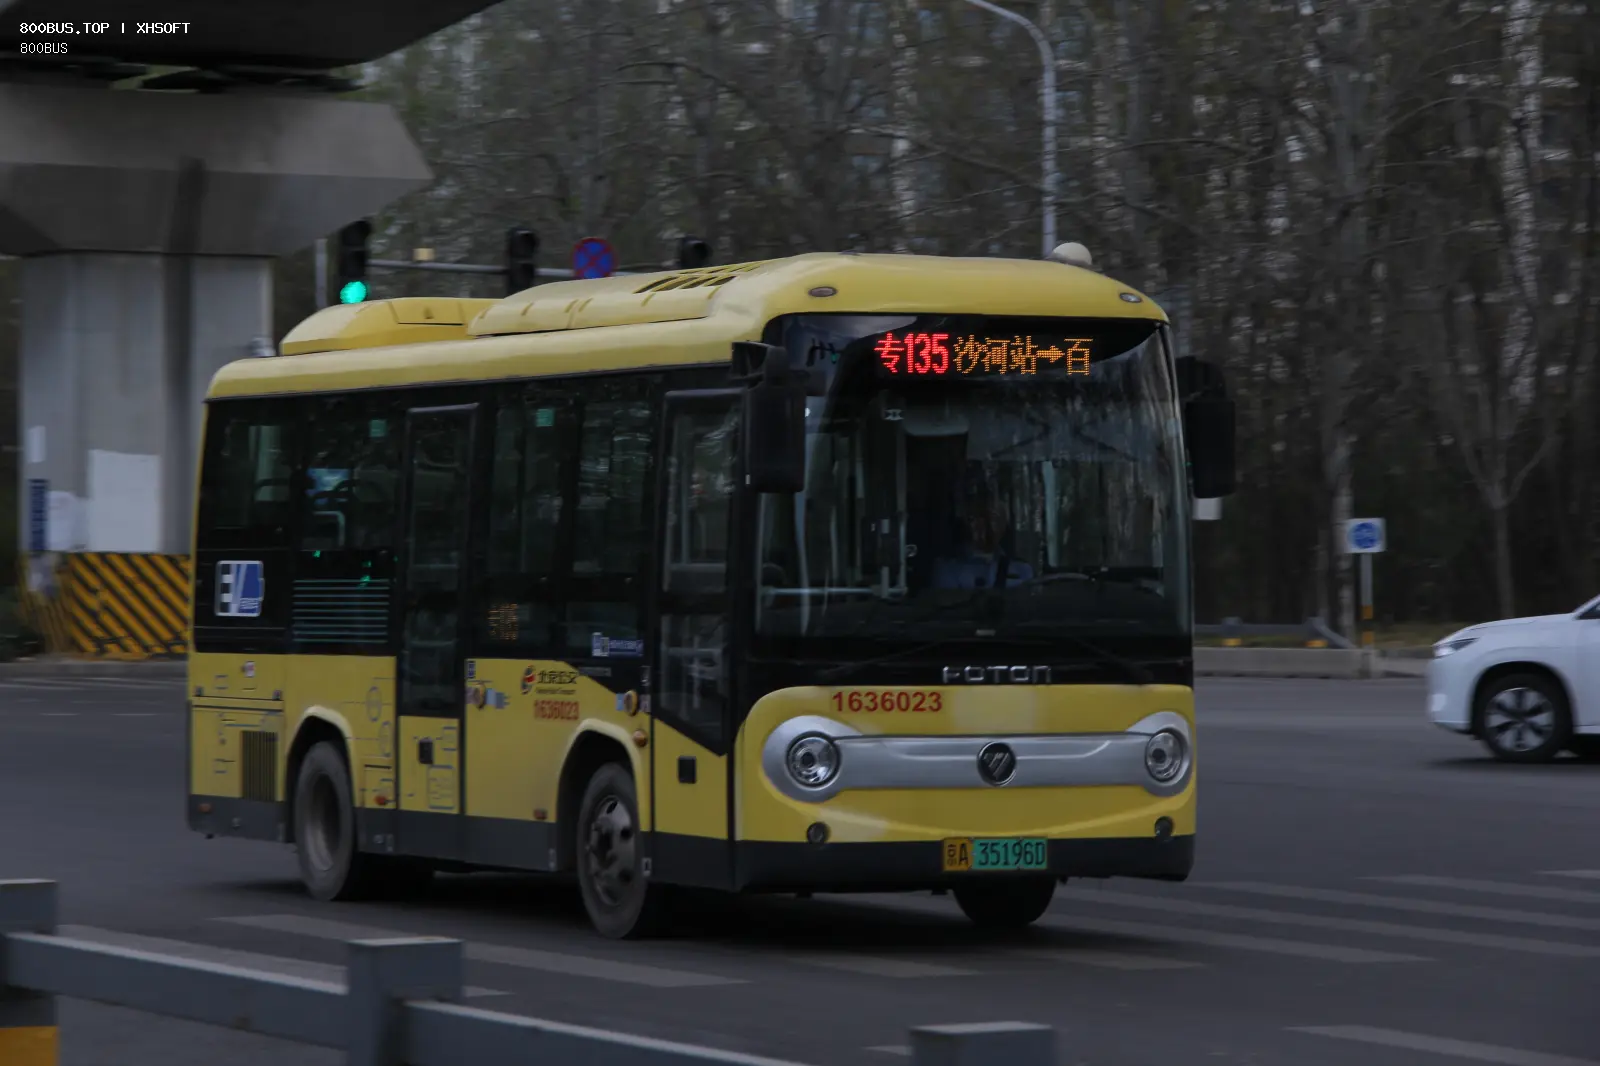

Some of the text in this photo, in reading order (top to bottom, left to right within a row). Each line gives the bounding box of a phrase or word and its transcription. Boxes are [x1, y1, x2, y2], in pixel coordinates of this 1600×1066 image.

[874, 332, 949, 374] 专135
[942, 665, 1052, 684] FOTON
[832, 691, 944, 713] 1636023
